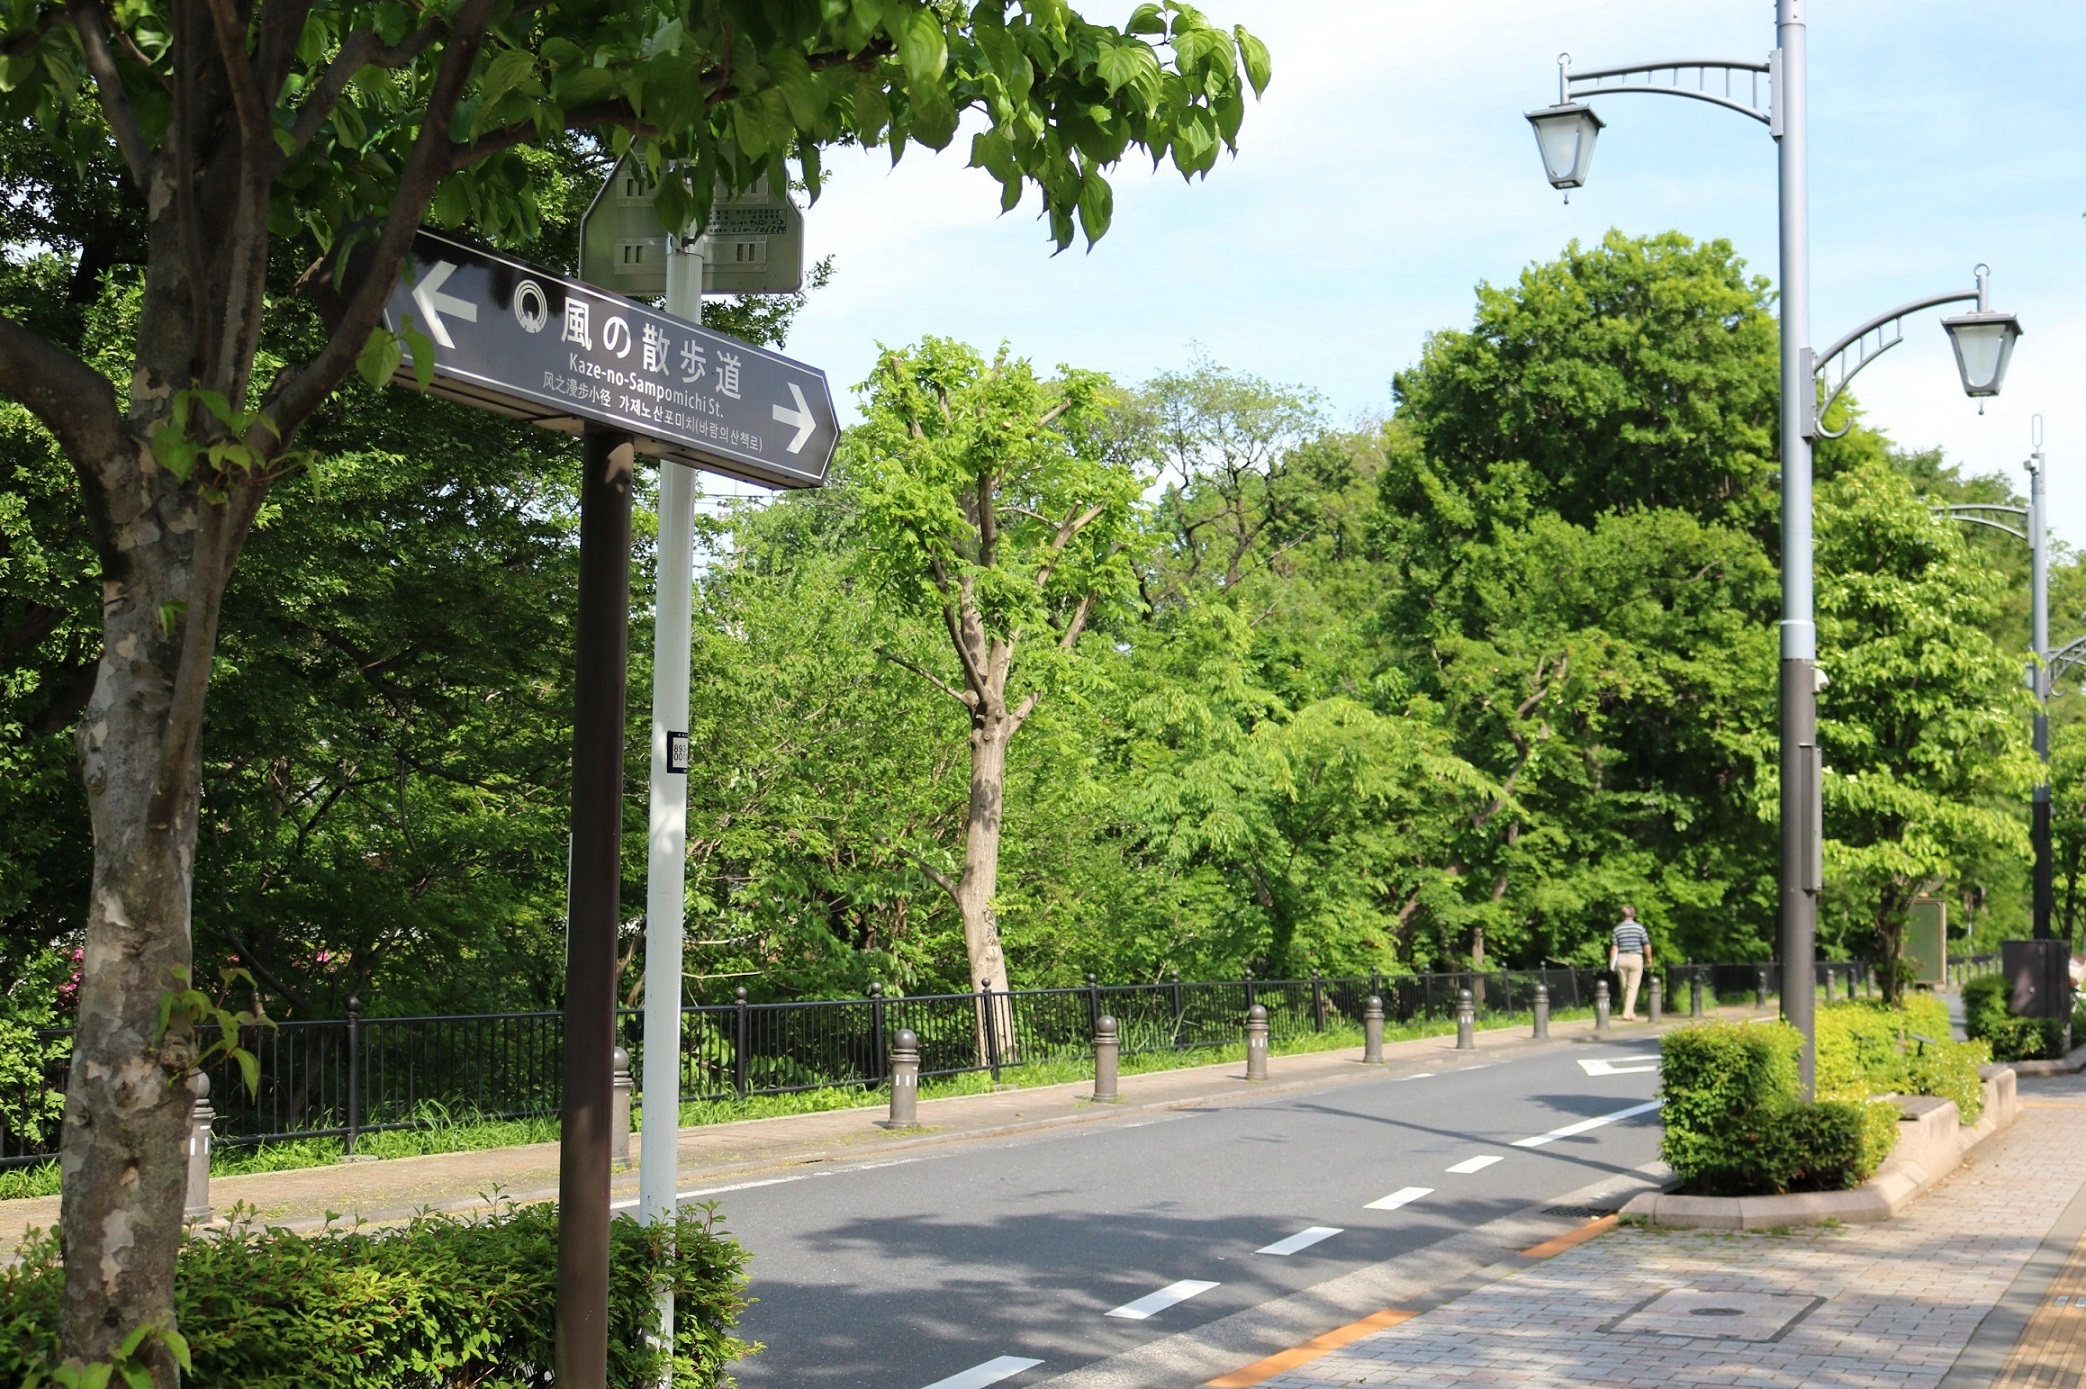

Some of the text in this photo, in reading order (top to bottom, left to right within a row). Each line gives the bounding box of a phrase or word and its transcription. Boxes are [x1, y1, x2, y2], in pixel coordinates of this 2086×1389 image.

[561, 296, 741, 400] 風の散歩道
[543, 371, 611, 408] 风之漫步小径
[569, 352, 724, 418] Kaze-no-Sampomichi St.
